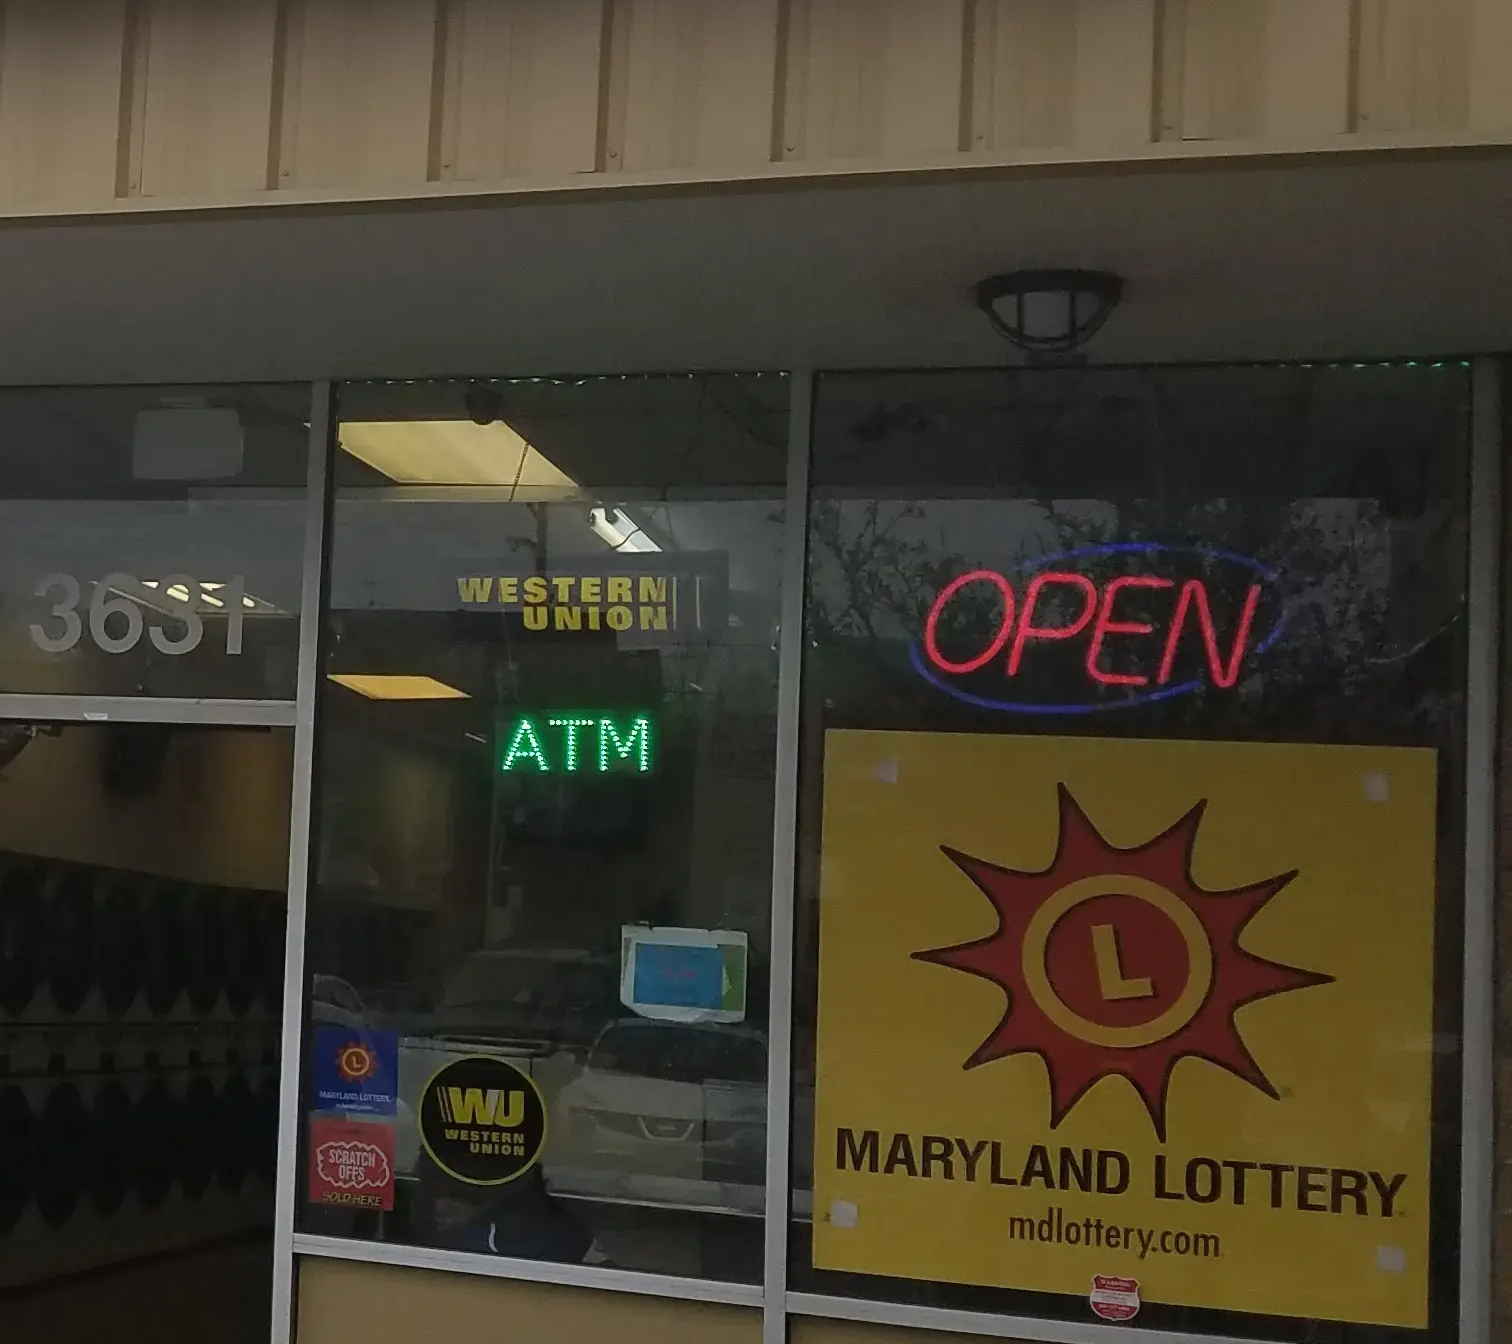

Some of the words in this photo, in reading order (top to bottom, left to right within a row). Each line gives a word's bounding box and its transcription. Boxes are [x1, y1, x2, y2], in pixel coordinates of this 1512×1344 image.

[457, 575, 668, 604] WESTERN
[28, 571, 248, 656] 3631
[522, 605, 669, 632] UNION
[924, 569, 1262, 689] OPEN
[500, 718, 650, 773] ATM
[448, 1086, 525, 1128] WU
[445, 1129, 525, 1144] WESTERN
[469, 1142, 525, 1156] UNION
[329, 1148, 376, 1168] SCRATCH
[338, 1165, 365, 1182] OFFS
[835, 1127, 1130, 1196] MARYLAND
[1153, 1154, 1408, 1219] LOTTERY
[323, 1191, 350, 1203] SOLD
[352, 1193, 383, 1206] HERE
[1008, 1207, 1221, 1259] mdlottery.com
